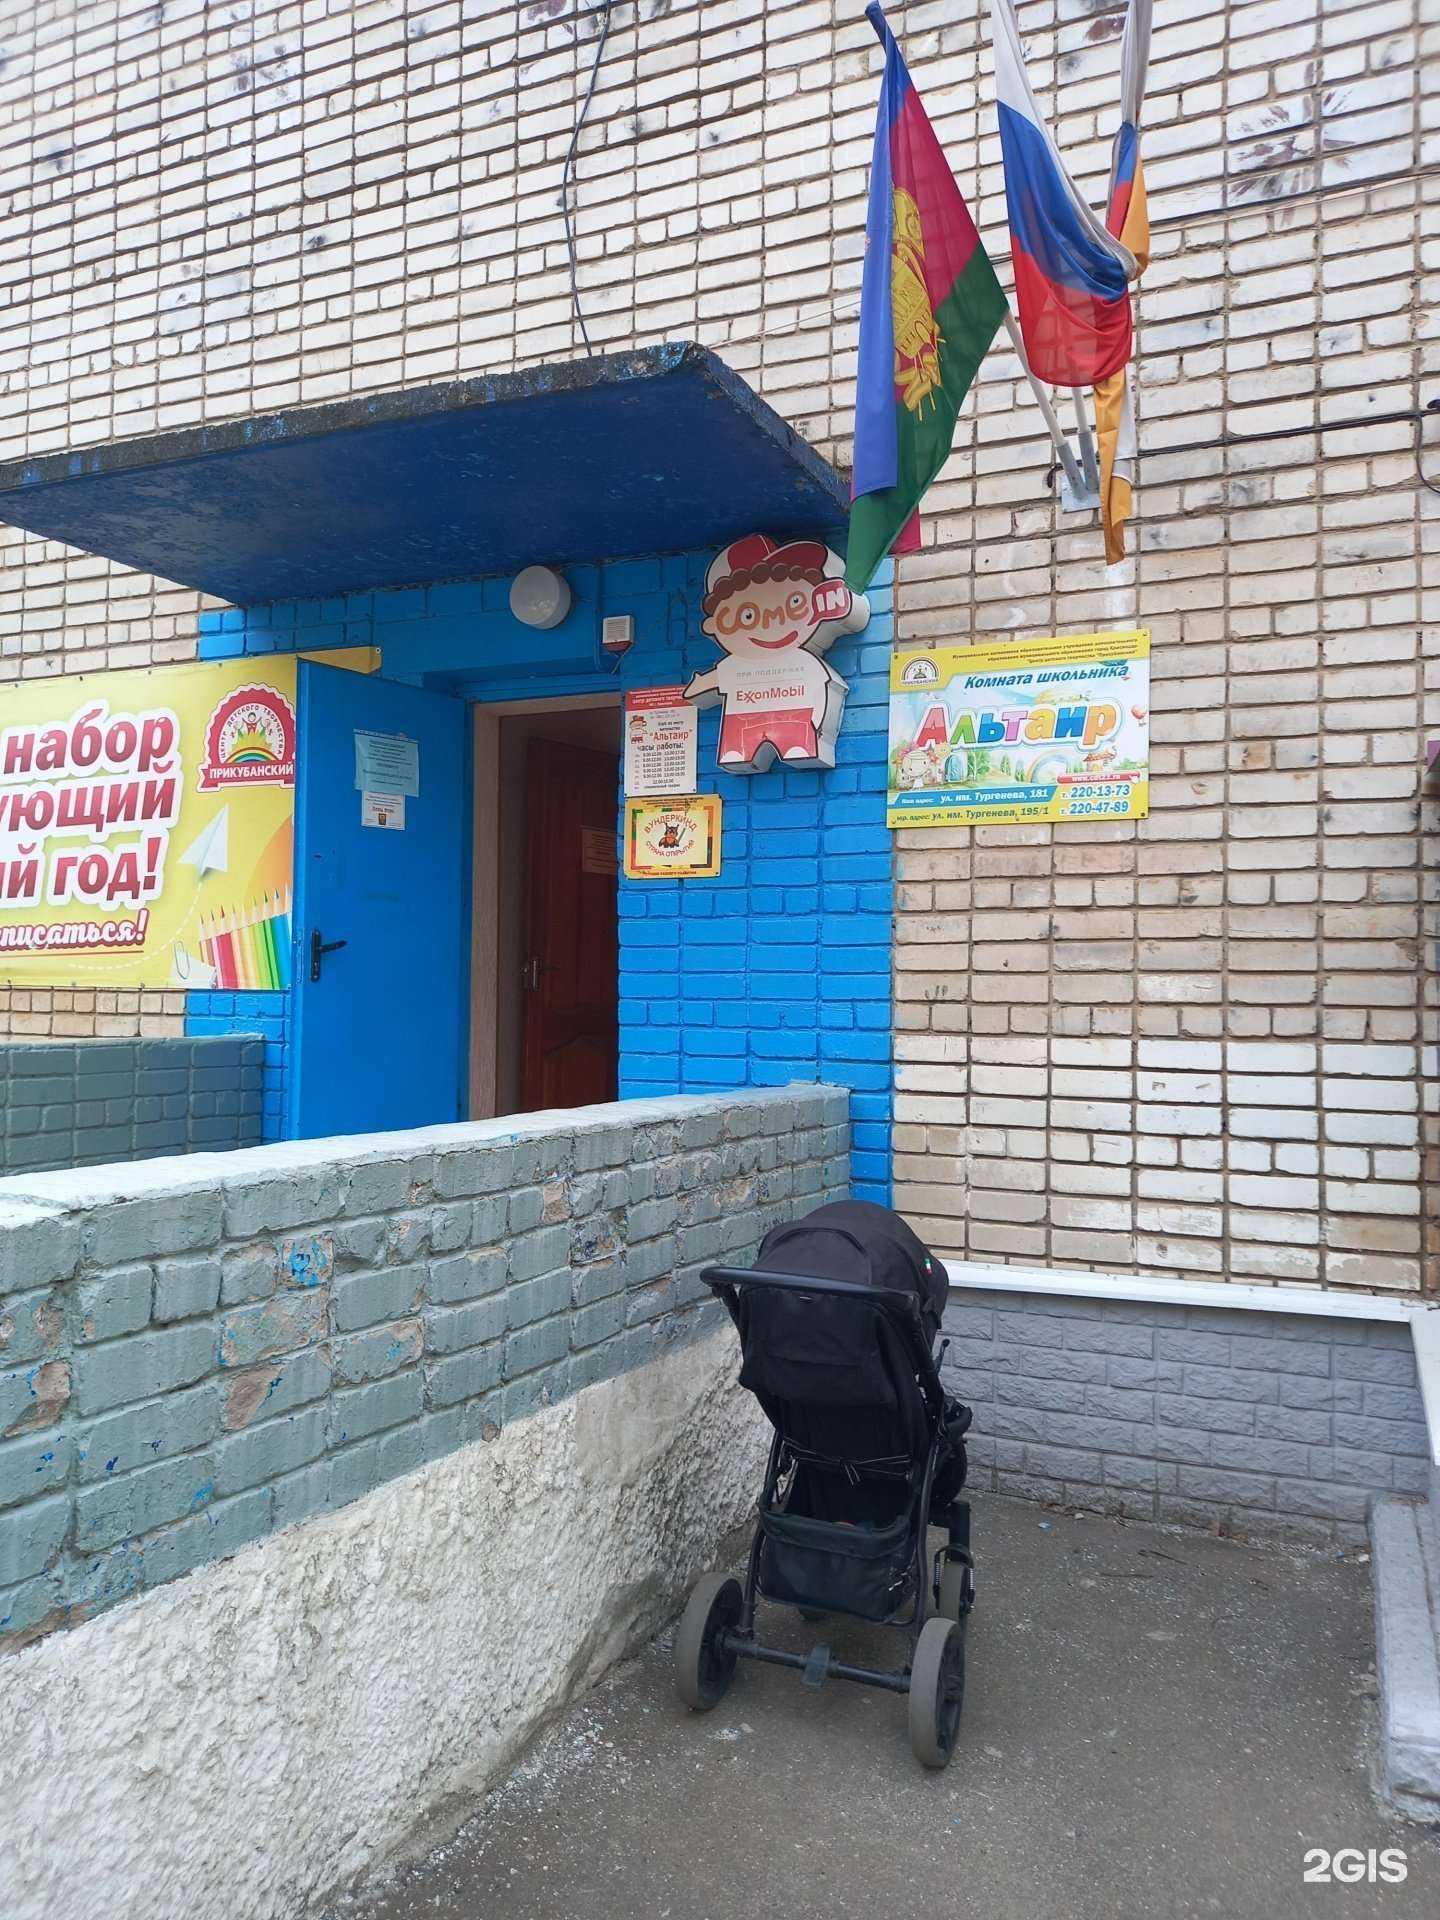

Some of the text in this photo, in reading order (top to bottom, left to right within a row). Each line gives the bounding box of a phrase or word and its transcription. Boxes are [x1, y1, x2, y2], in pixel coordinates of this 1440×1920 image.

[815, 588, 846, 612] IN
[965, 666, 1129, 689] Комната школьника
[736, 685, 805, 703] ExxonMobil
[916, 704, 1117, 748] Альтаир
[3, 708, 174, 774] набор
[209, 762, 294, 779] ПРИКУБАНСКИЙ
[0, 761, 177, 832] ющий
[940, 794, 952, 804] ул.
[975, 791, 1028, 802] Тургенева,
[1030, 789, 1048, 798] 181
[1071, 784, 1130, 798] 220-13-73
[931, 812, 944, 821] ул.
[966, 809, 1018, 819] Тургенева,
[1021, 807, 1049, 816] 195/1
[1070, 801, 1129, 814] 220-47-89
[644, 814, 698, 834] ВУНДЕРКИНД
[53, 837, 162, 901] год!
